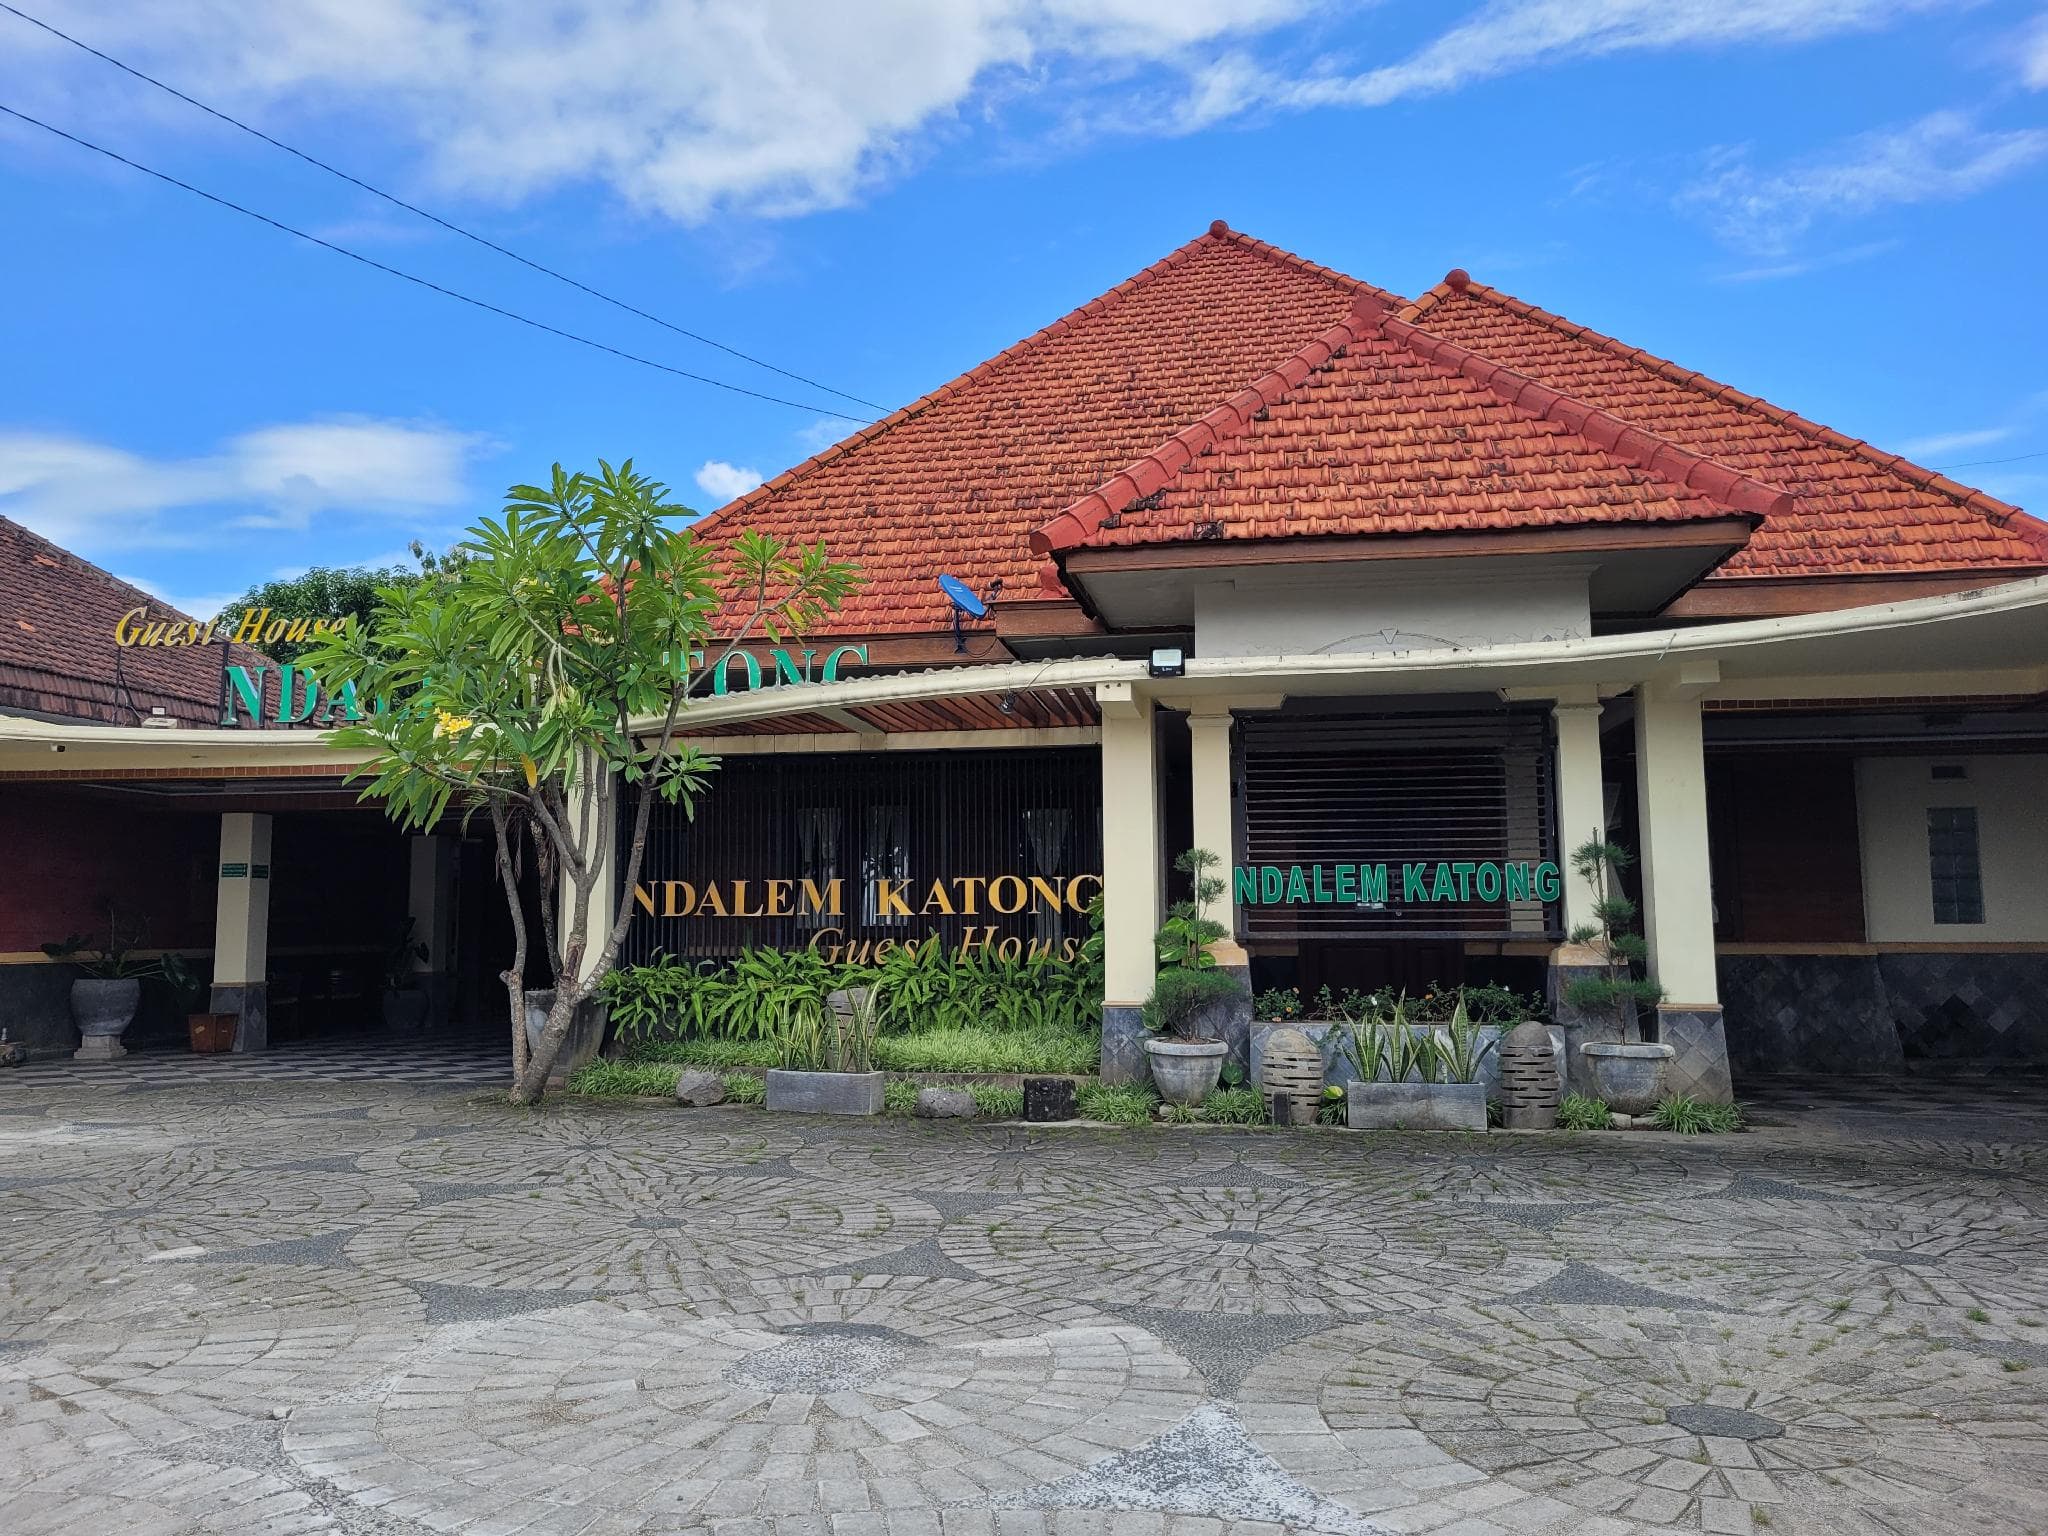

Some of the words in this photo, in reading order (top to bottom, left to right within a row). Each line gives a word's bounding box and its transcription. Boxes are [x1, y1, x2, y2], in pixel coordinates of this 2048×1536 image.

[115, 606, 218, 647] Guest
[221, 664, 433, 726] NDA
[624, 879, 844, 917] NDALEM
[875, 874, 1103, 916] KATONG
[1234, 863, 1389, 904] NDALEM
[1403, 861, 1560, 902] KATONG
[809, 927, 930, 967] Gues
[955, 925, 1080, 964] Hous
